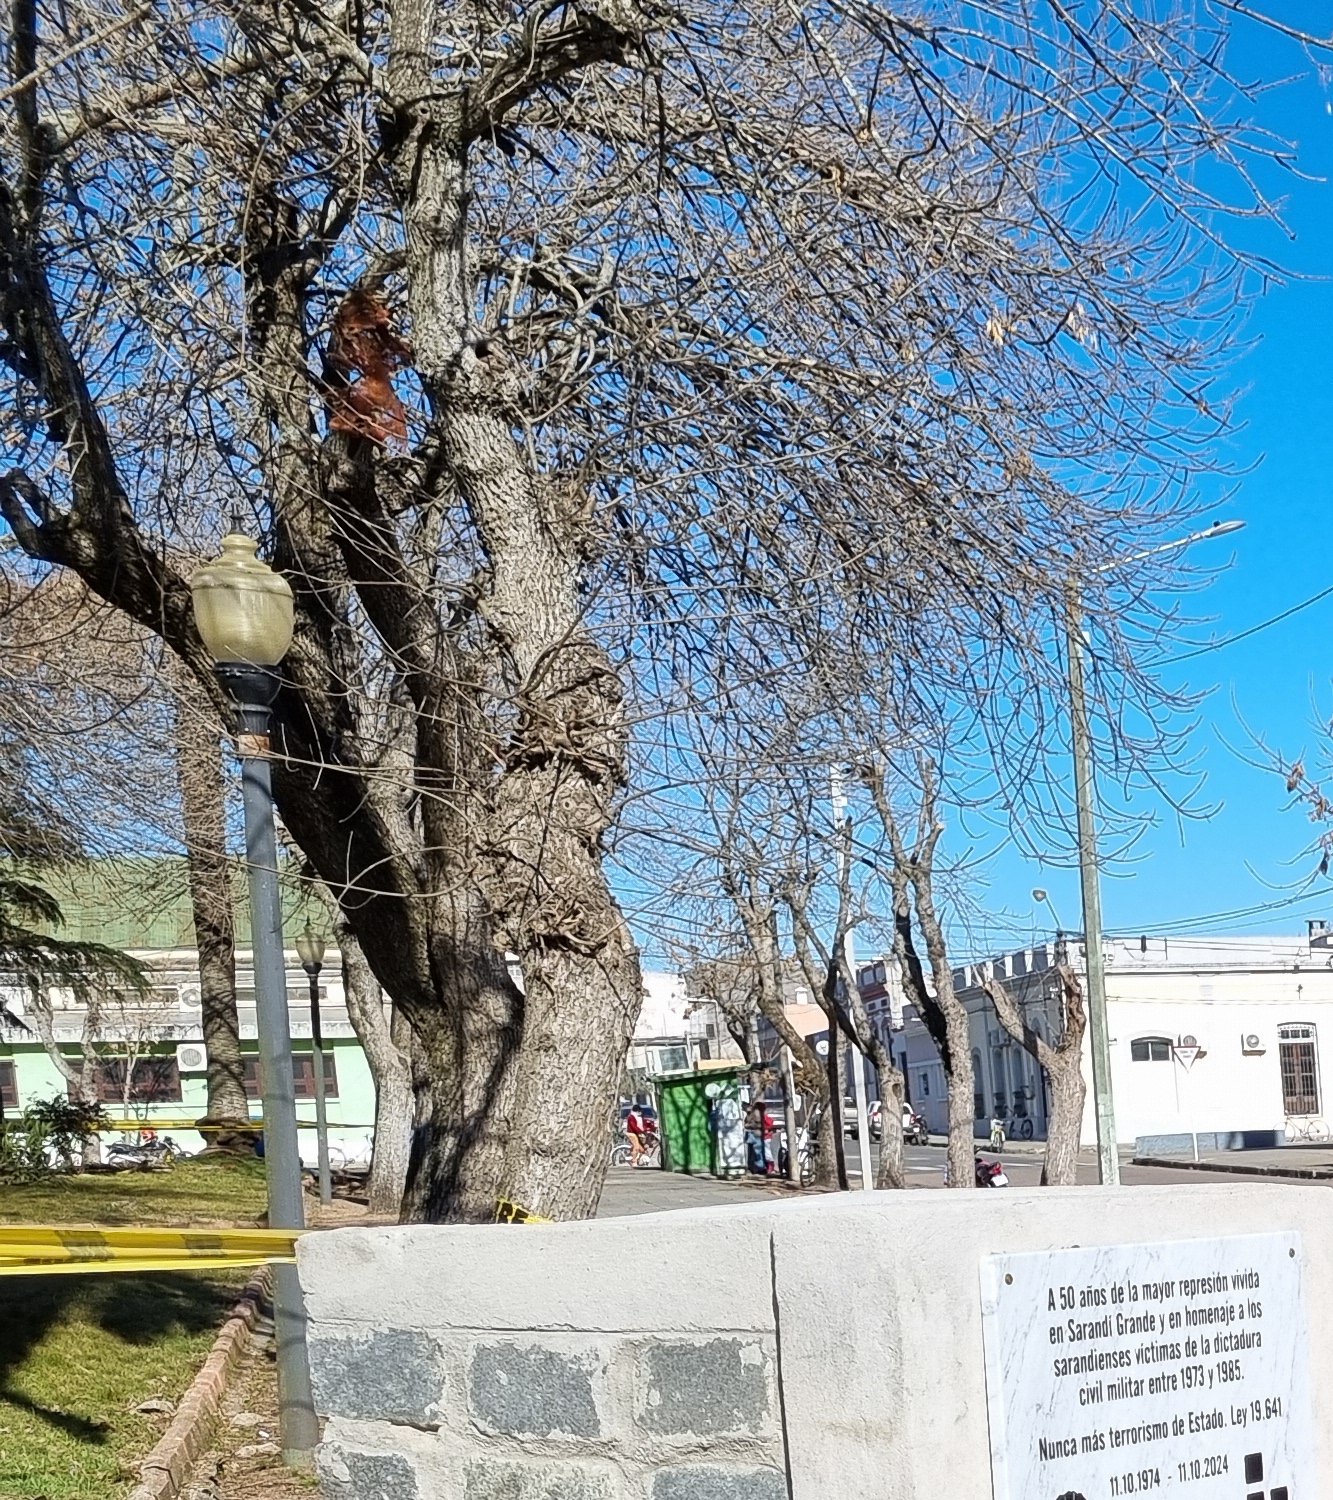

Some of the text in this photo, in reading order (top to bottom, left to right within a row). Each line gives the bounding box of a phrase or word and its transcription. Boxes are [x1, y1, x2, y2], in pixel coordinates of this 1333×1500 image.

[1048, 1268, 1259, 1311] A 50 años de la mayor represión vivida
[1050, 1298, 1262, 1344] en Sarandí Grande y en homenaje a los
[1054, 1329, 1261, 1377] sarandienses víctimas de la dictadura
[1080, 1359, 1244, 1406] civil militar entre 1973 y 1985.
[1039, 1397, 1282, 1461] Nunca más terrorismo de Estado. Ley 19.641
[1110, 1468, 1160, 1497] 11.10.1974
[1178, 1454, 1228, 1482] 11.10.2024
